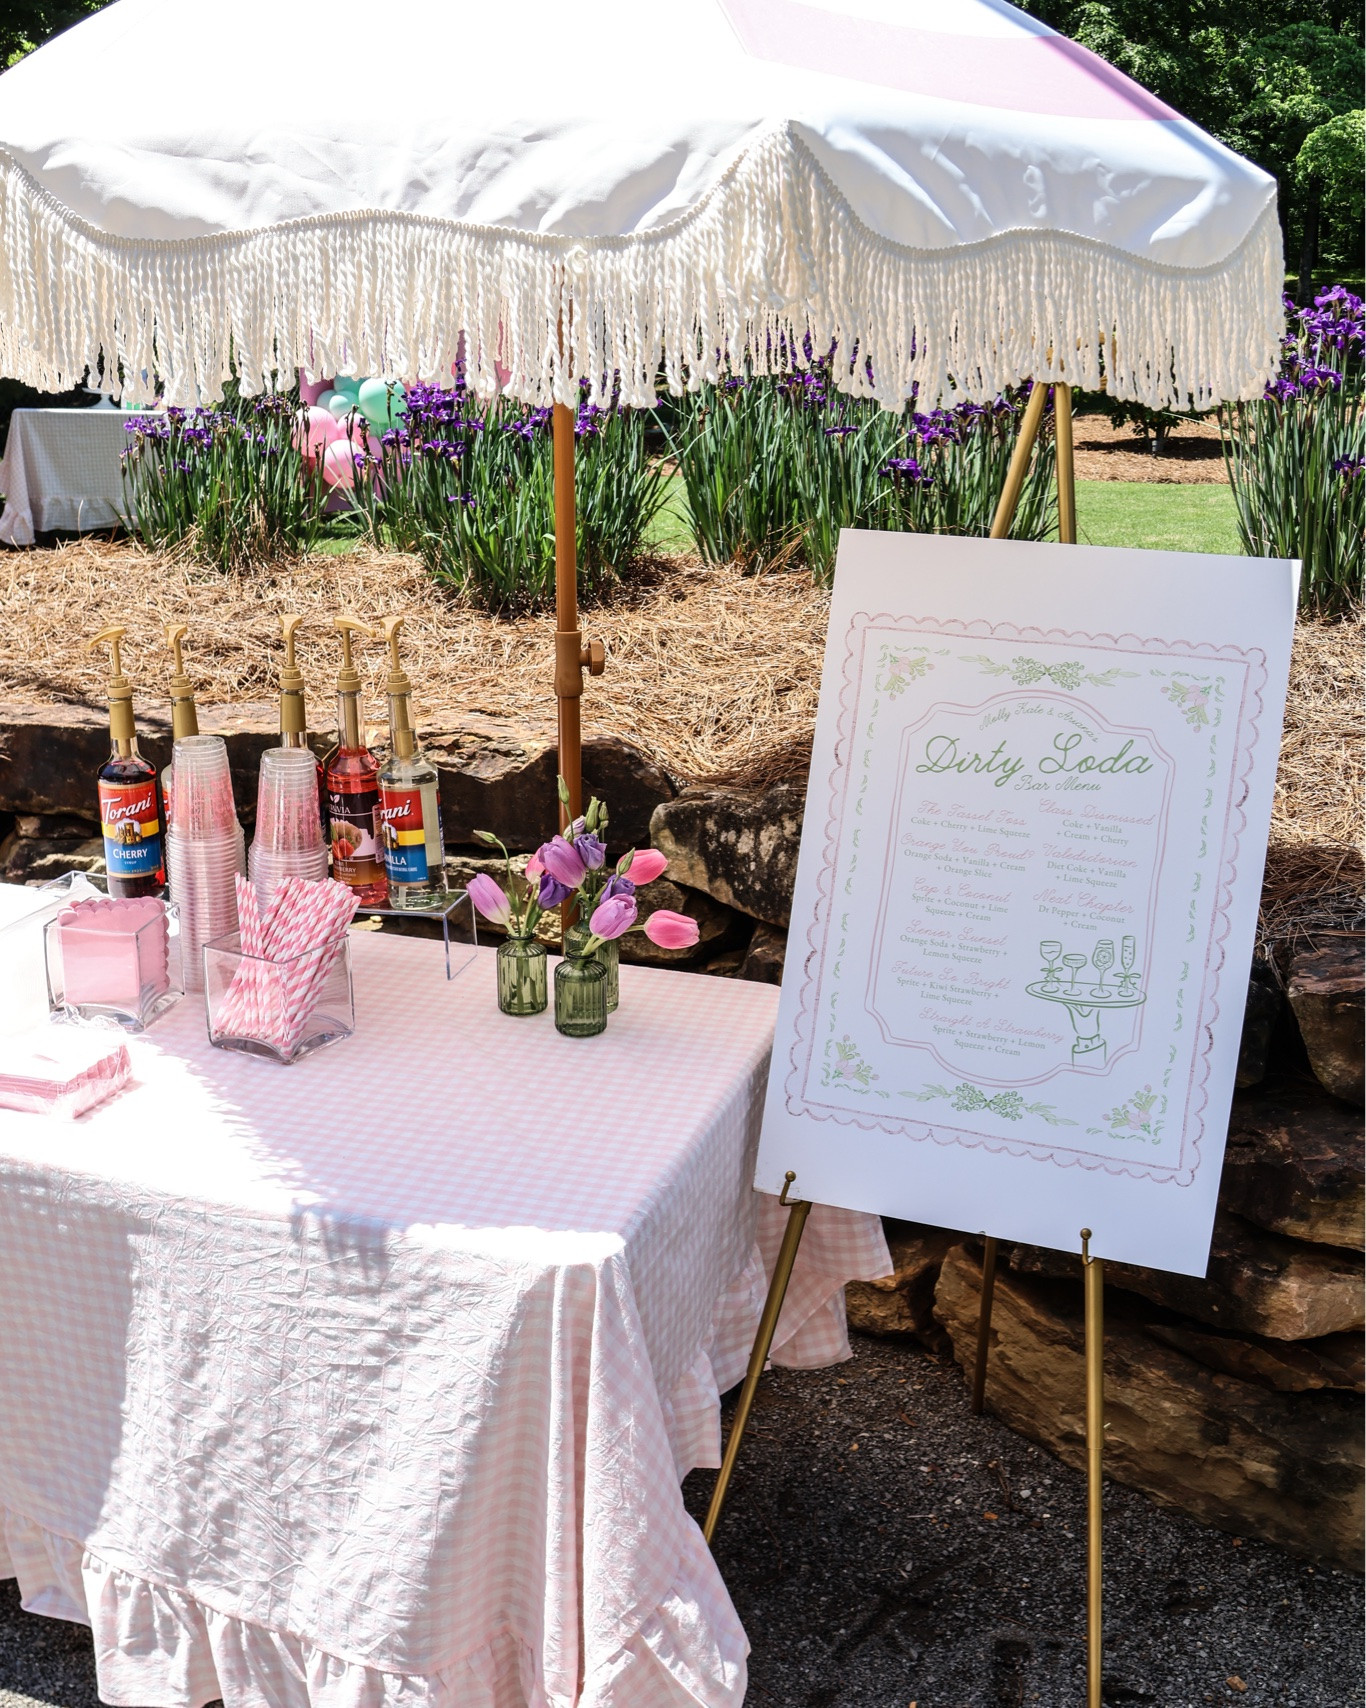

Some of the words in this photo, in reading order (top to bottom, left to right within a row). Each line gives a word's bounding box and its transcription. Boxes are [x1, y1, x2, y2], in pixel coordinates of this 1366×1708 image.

[979, 707, 1011, 731] Molly
[1015, 702, 1044, 715] Kate
[916, 735, 1025, 787] Dirty
[1038, 733, 1153, 774] Soda
[1014, 775, 1050, 791] Bar
[1055, 776, 1101, 791] Menu
[101, 792, 151, 825] Torani
[917, 800, 943, 814] The
[947, 803, 995, 821] Tassel
[996, 810, 1027, 826] Toss
[1039, 798, 1073, 816] Class
[1080, 805, 1156, 825] Dismissed
[911, 817, 930, 826] Coke
[941, 820, 967, 831] Cherry
[978, 825, 997, 834] Lime
[999, 827, 1031, 838] Squeeze
[1062, 820, 1083, 828] Coke
[1094, 823, 1122, 833] Vanilla
[901, 833, 946, 853] Orange
[952, 838, 978, 854] You
[984, 843, 1035, 860] Proud?
[1064, 831, 1090, 840] Cream
[1101, 835, 1129, 847] Cherry
[113, 848, 148, 859] CHERRY
[904, 849, 932, 861] Orange
[934, 853, 952, 861] Soda
[963, 857, 990, 867] Vanilla
[1000, 862, 1025, 871] Cream
[1043, 843, 1138, 868] Valedictorian
[944, 865, 972, 876] Orange
[975, 869, 992, 878] Slice
[1047, 861, 1064, 869] Diet
[1067, 864, 1087, 873] Coke
[1098, 868, 1126, 878] Vanilla
[912, 876, 940, 896] Cap
[944, 886, 952, 895] &
[958, 883, 1012, 902] Coconut
[1064, 874, 1083, 883] Lime
[1086, 878, 1118, 888] Squeeze
[912, 893, 934, 903] Sprite
[944, 898, 978, 909] Coconut
[988, 904, 1008, 913] Lime
[1033, 888, 1073, 904] Next
[1078, 892, 1135, 913] Chapter
[925, 906, 955, 916] Squeeze
[966, 912, 991, 921] Cream
[1052, 906, 1079, 918] Pepper
[1090, 912, 1125, 923] Coconut
[906, 919, 952, 938] Senior
[957, 927, 1008, 945] Sunset
[1071, 921, 1097, 930] Cream
[900, 935, 927, 946] Orange
[930, 938, 948, 948] Soda
[958, 943, 1000, 957] Strawberry
[923, 948, 949, 958] Lemon
[952, 952, 982, 963] Squeeze
[892, 961, 933, 978] Future
[939, 968, 958, 981] So
[963, 972, 1012, 991] Bright
[896, 977, 919, 988] Sprite
[930, 982, 947, 990] Kiwi
[949, 985, 991, 998] Strawberry
[920, 991, 940, 1000] Lime
[942, 994, 973, 1006] Squeeze
[918, 1007, 972, 1026] Straight
[976, 1018, 992, 1029] A
[994, 1018, 1064, 1043] Strawberry
[932, 1024, 956, 1035] Sprite
[966, 1030, 1008, 1043] Strawberry
[1018, 1039, 1046, 1050] Lemon
[954, 1039, 984, 1050] Squeeze
[995, 1046, 1020, 1056] Cream
